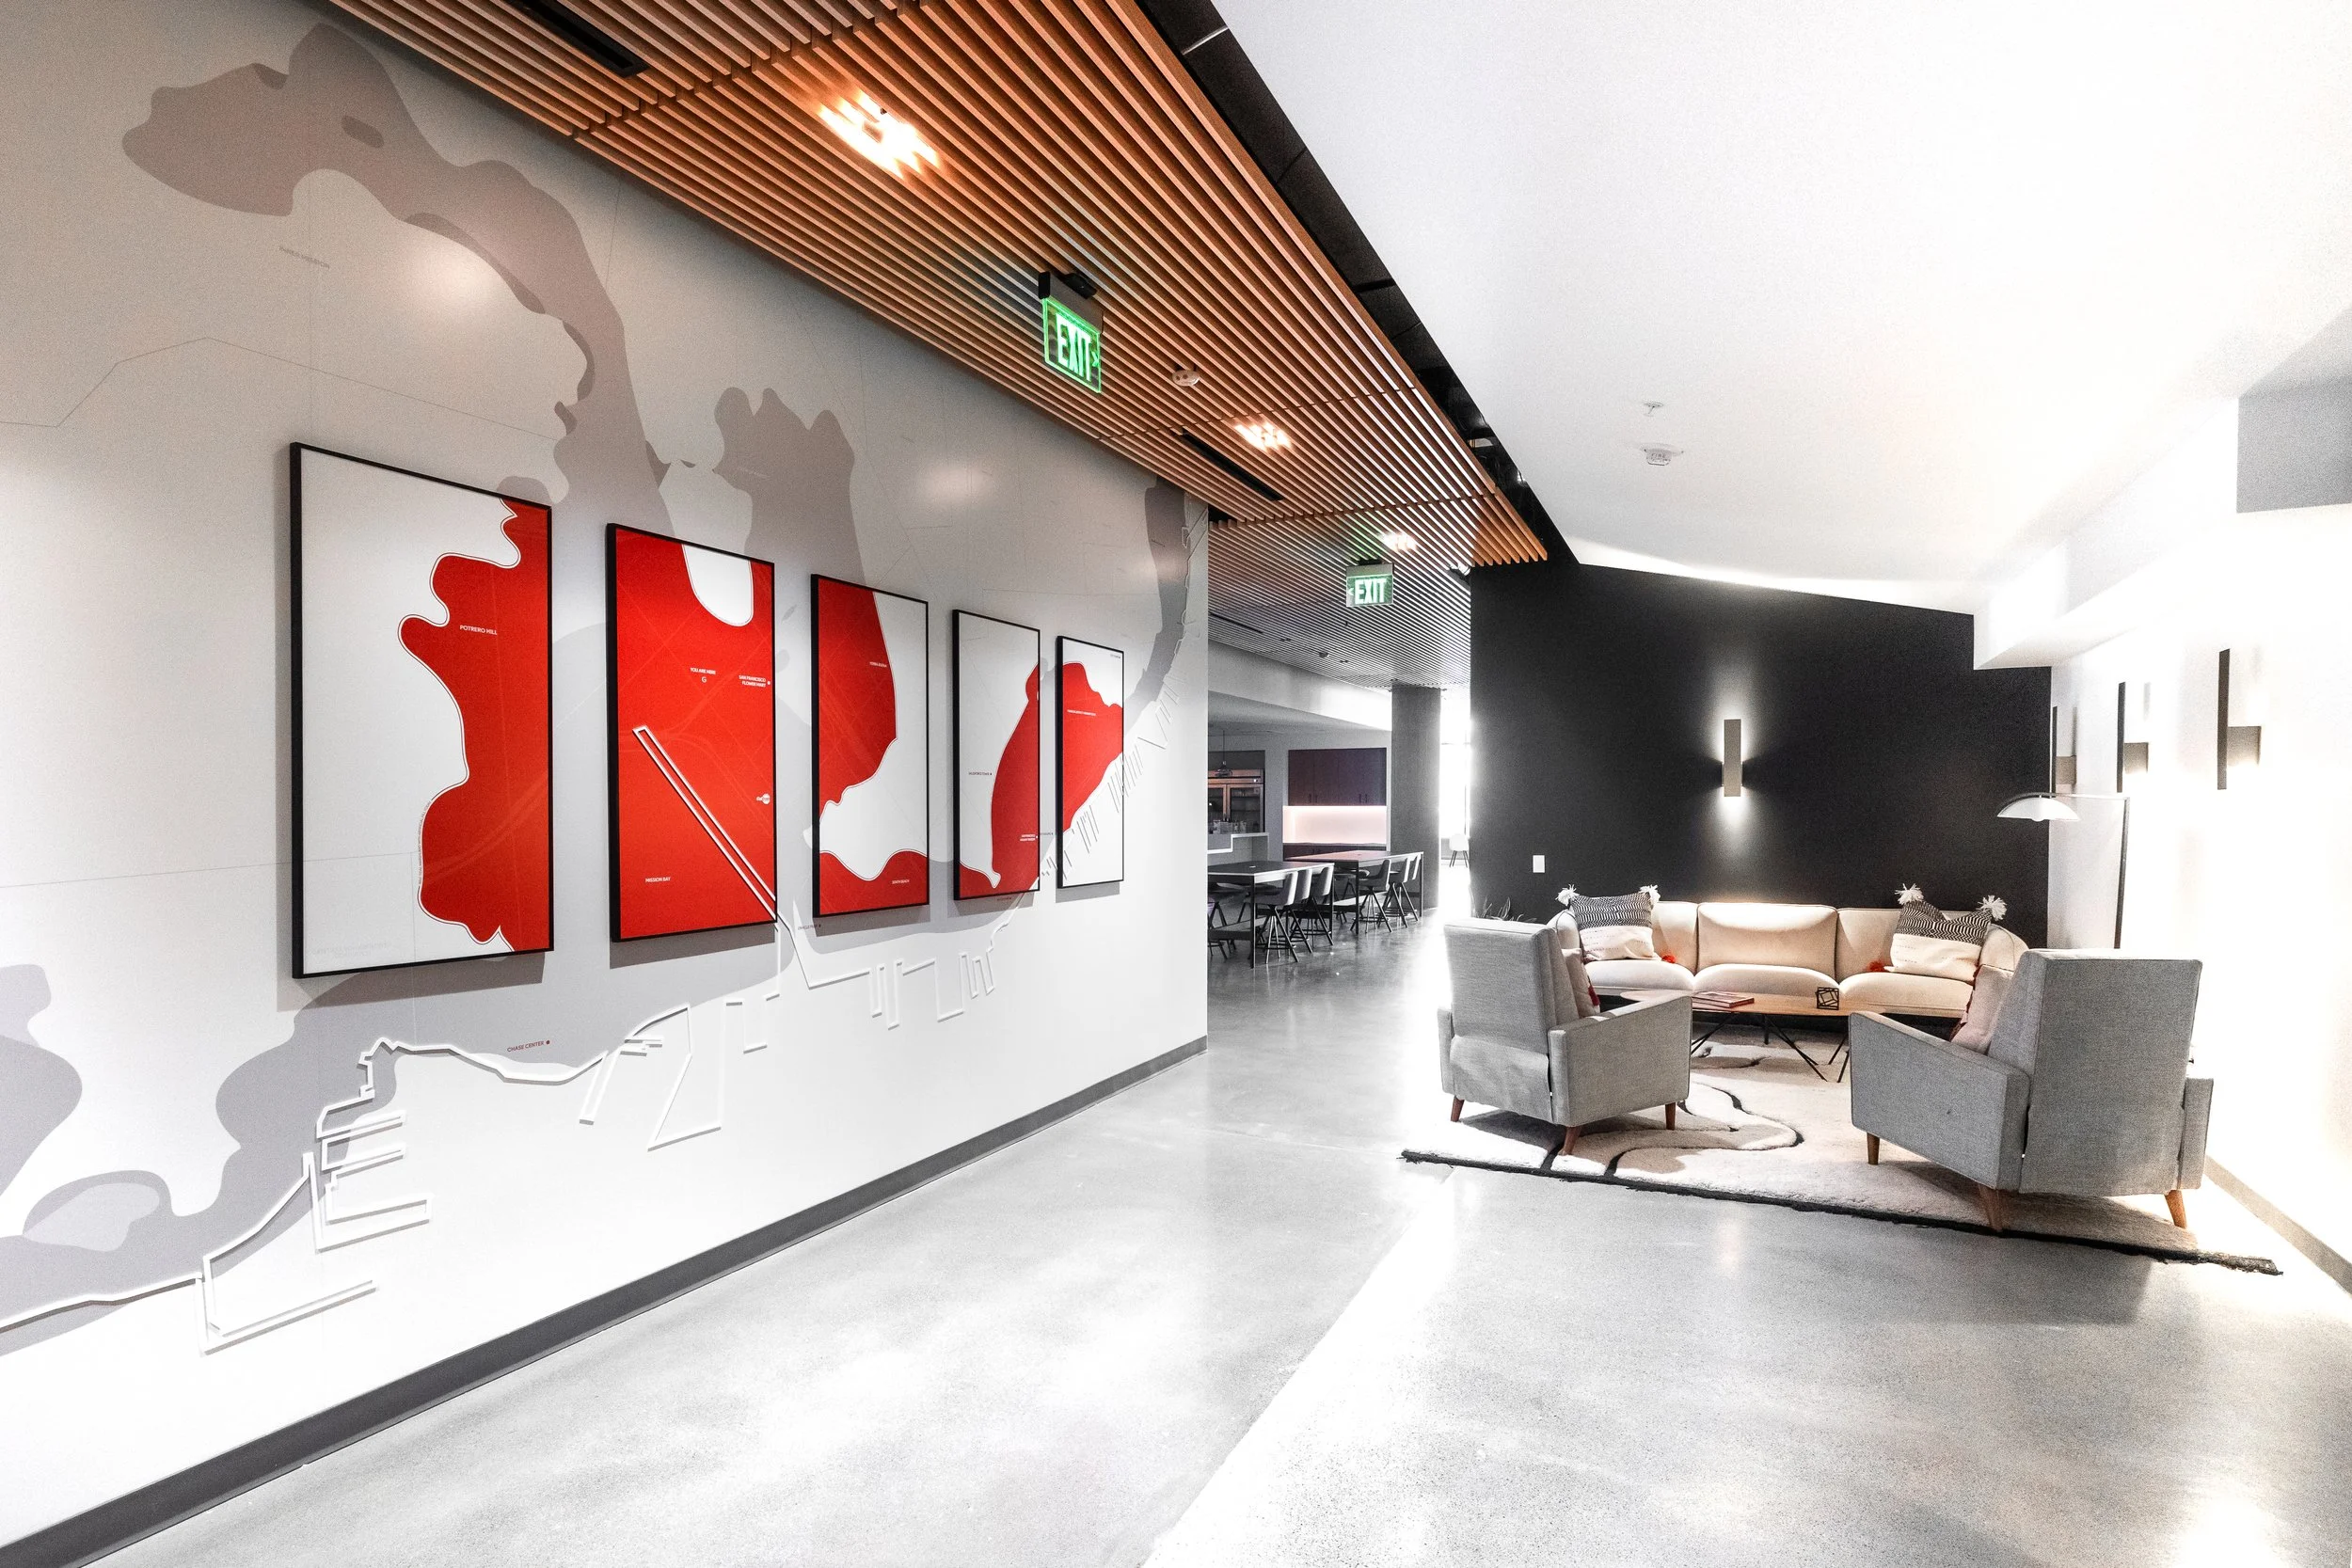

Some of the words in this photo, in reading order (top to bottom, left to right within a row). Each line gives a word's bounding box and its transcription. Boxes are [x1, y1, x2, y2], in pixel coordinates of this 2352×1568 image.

[1056, 312, 1092, 382] EXIT
[1355, 578, 1388, 605] EXIT
[459, 625, 486, 633] POTRERO
[507, 1044, 525, 1053] CHASE
[525, 1040, 545, 1049] CENTER
